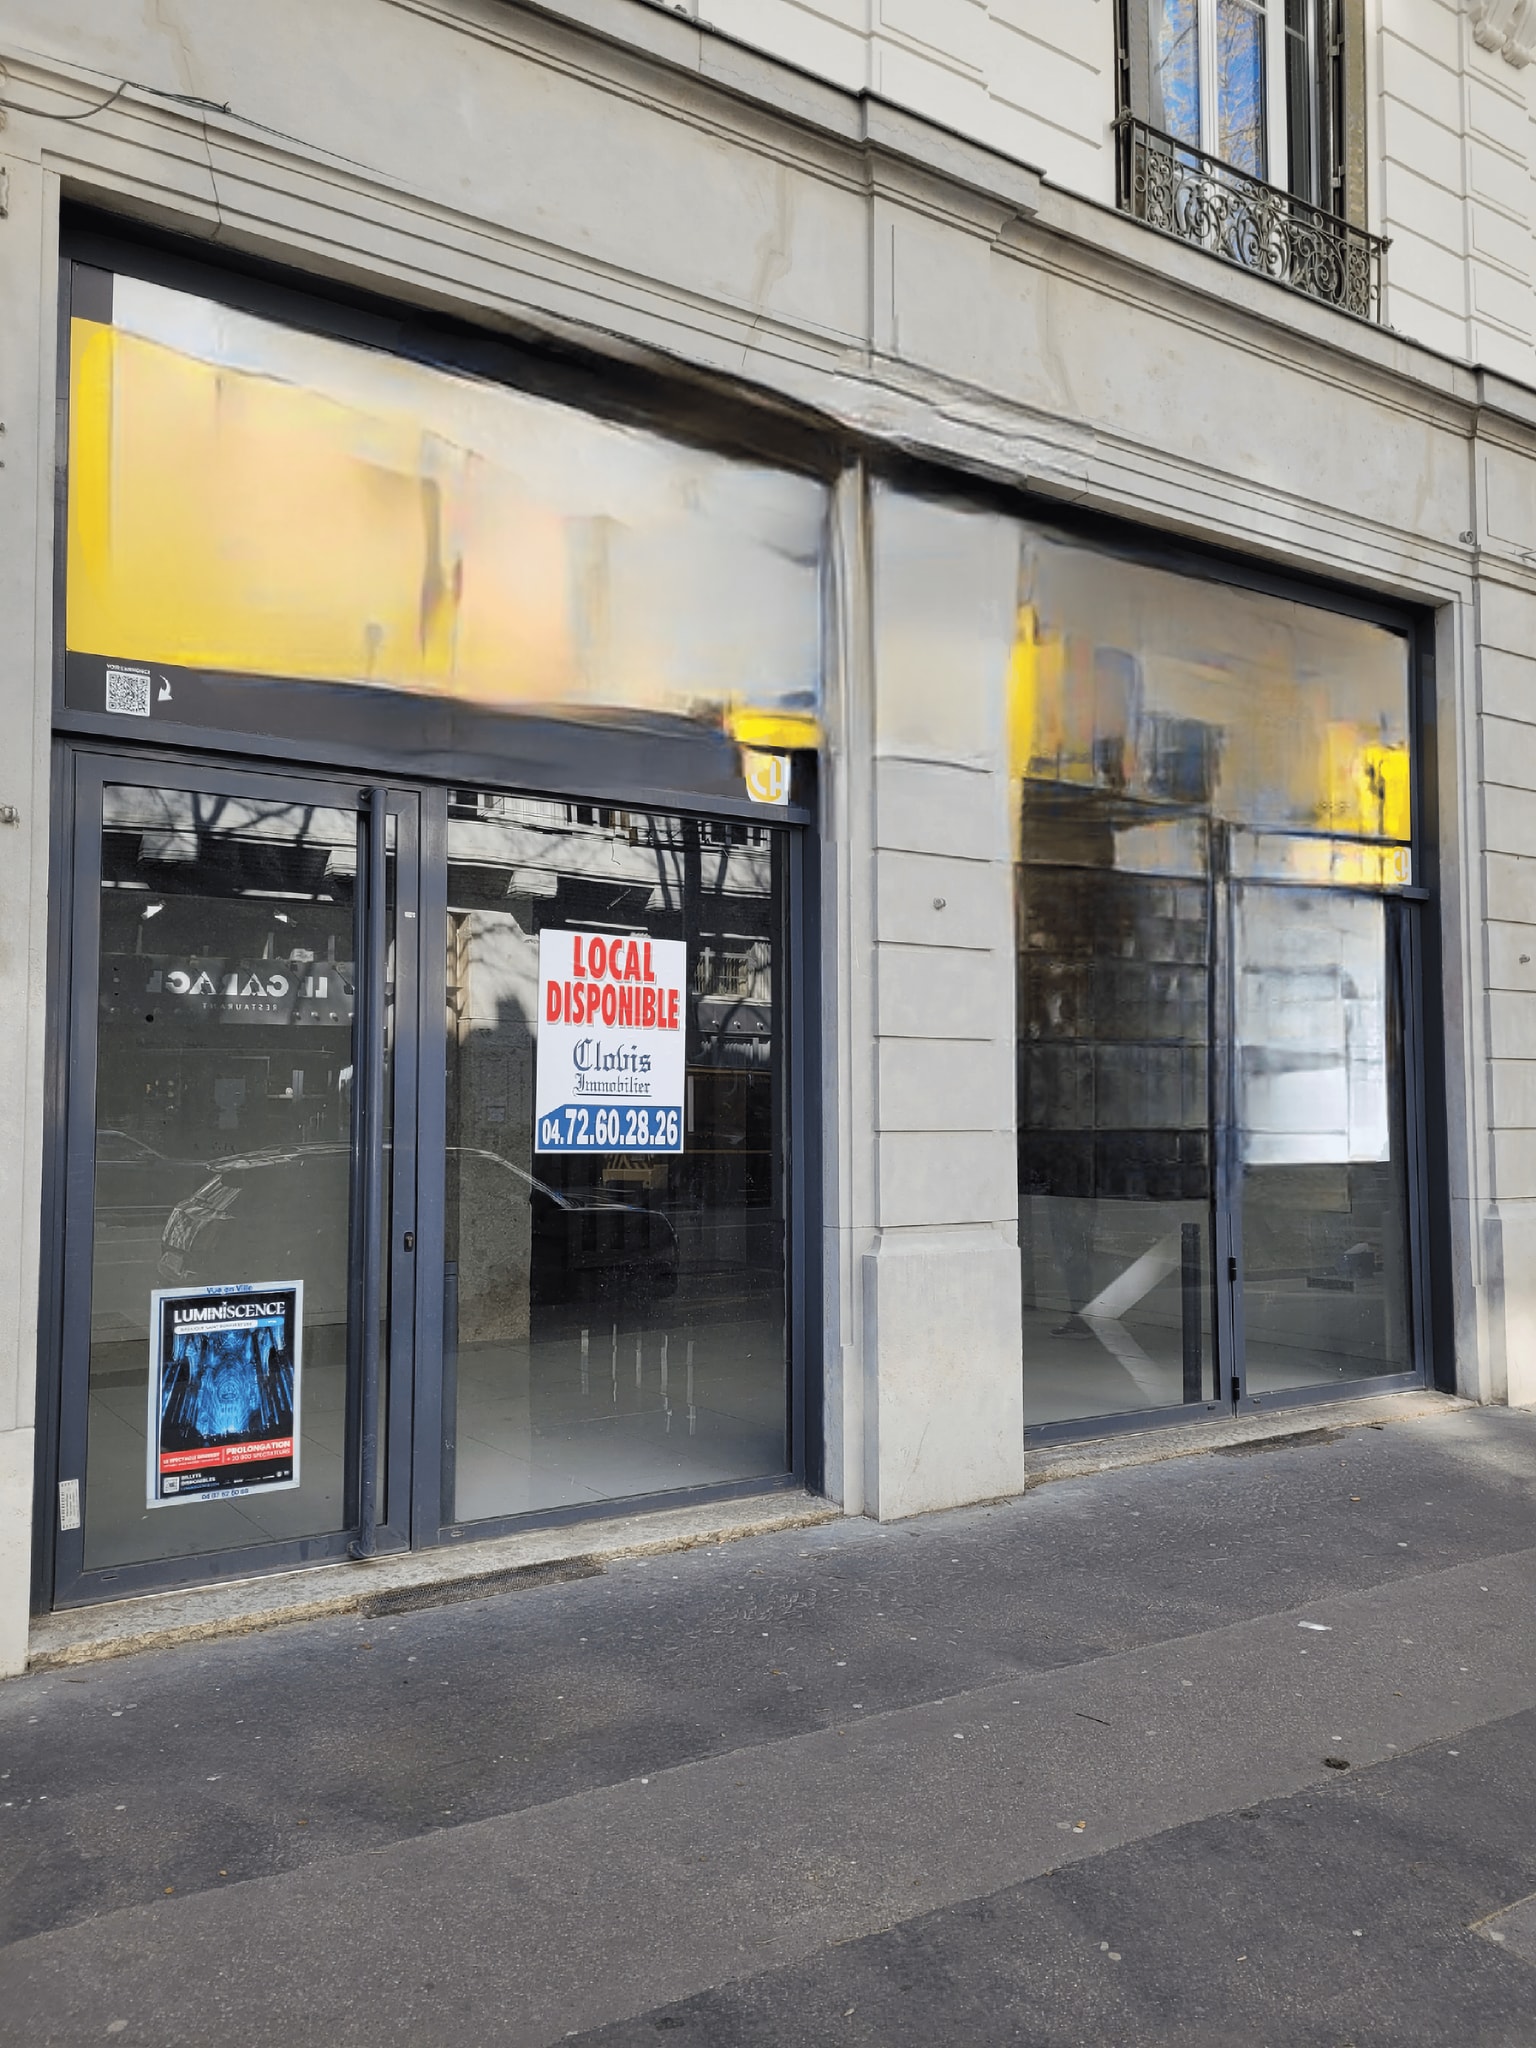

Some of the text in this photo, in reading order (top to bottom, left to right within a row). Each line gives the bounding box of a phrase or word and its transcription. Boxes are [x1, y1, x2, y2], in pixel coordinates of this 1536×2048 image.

[572, 935, 657, 984] LOCAL
[546, 979, 680, 1031] DISPONIBLE
[572, 1038, 652, 1074] Clovis
[573, 1073, 652, 1094] Immobilier
[542, 1108, 679, 1146] 04.72.60.28.26
[174, 1302, 285, 1323] LUMINISCENCE
[226, 1441, 290, 1455] PROLONGATION
